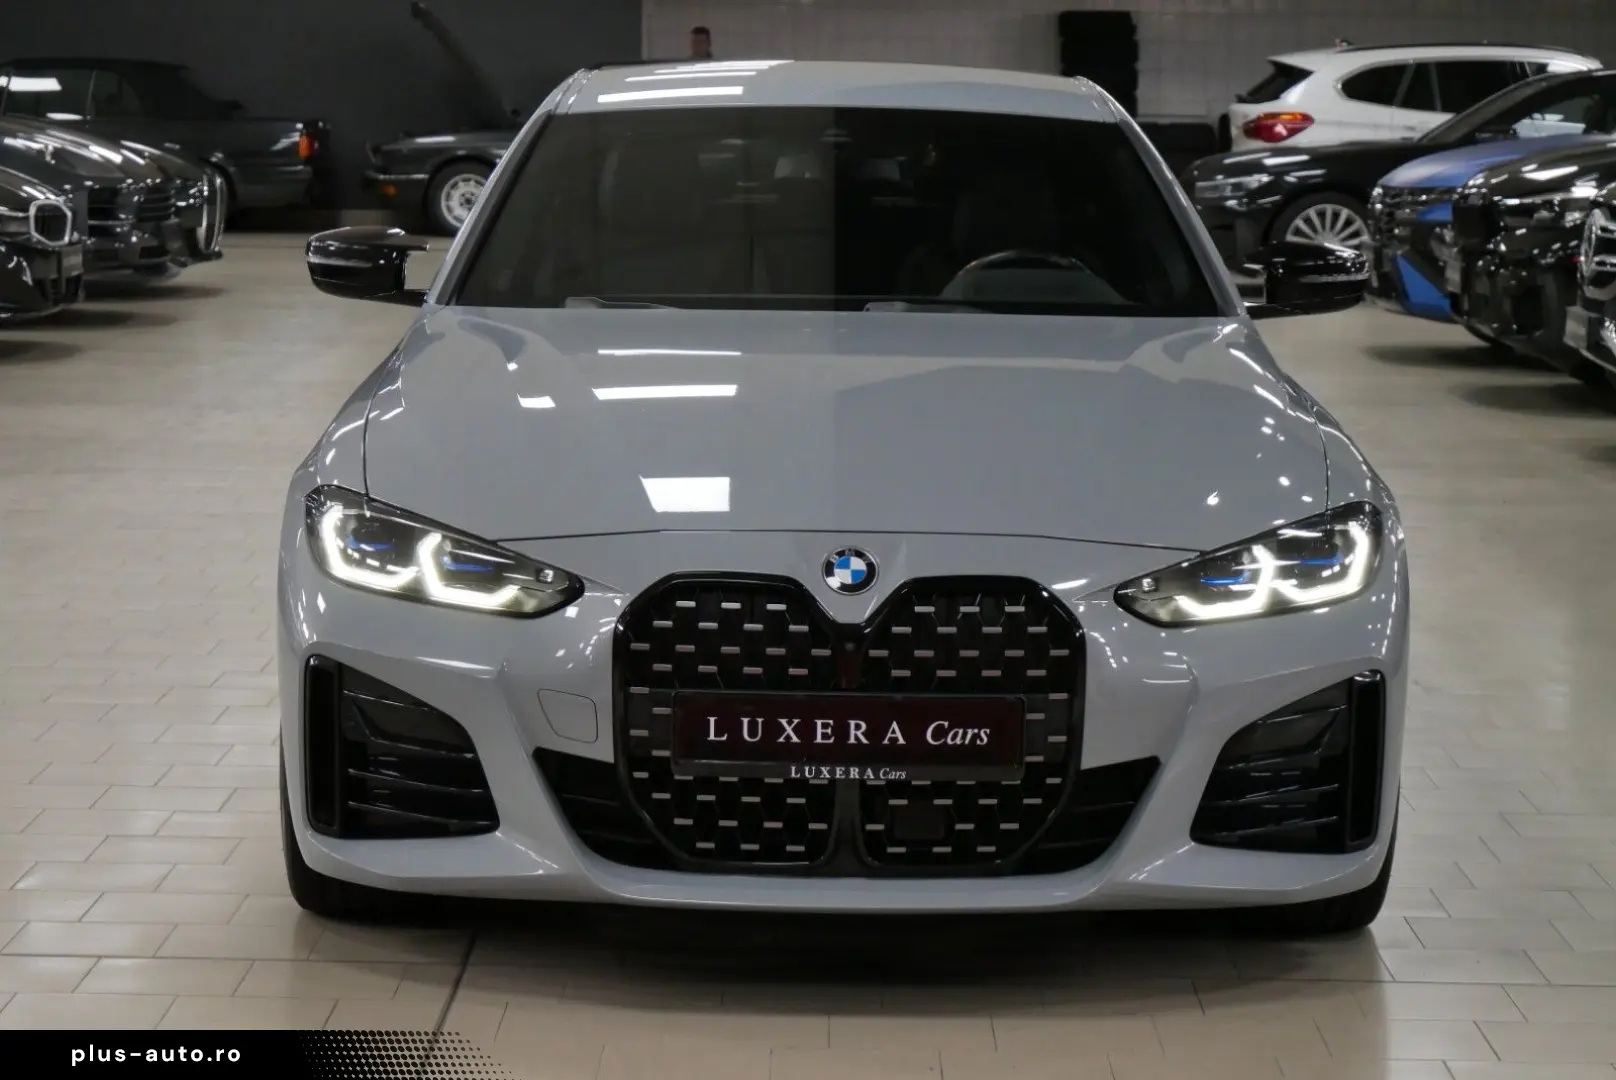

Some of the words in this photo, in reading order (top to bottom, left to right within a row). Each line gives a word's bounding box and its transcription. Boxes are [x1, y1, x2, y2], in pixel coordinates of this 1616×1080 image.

[707, 716, 907, 745] LUXERA
[925, 720, 990, 745] Cars
[790, 766, 875, 779] LUXERA
[880, 767, 907, 780] Cars
